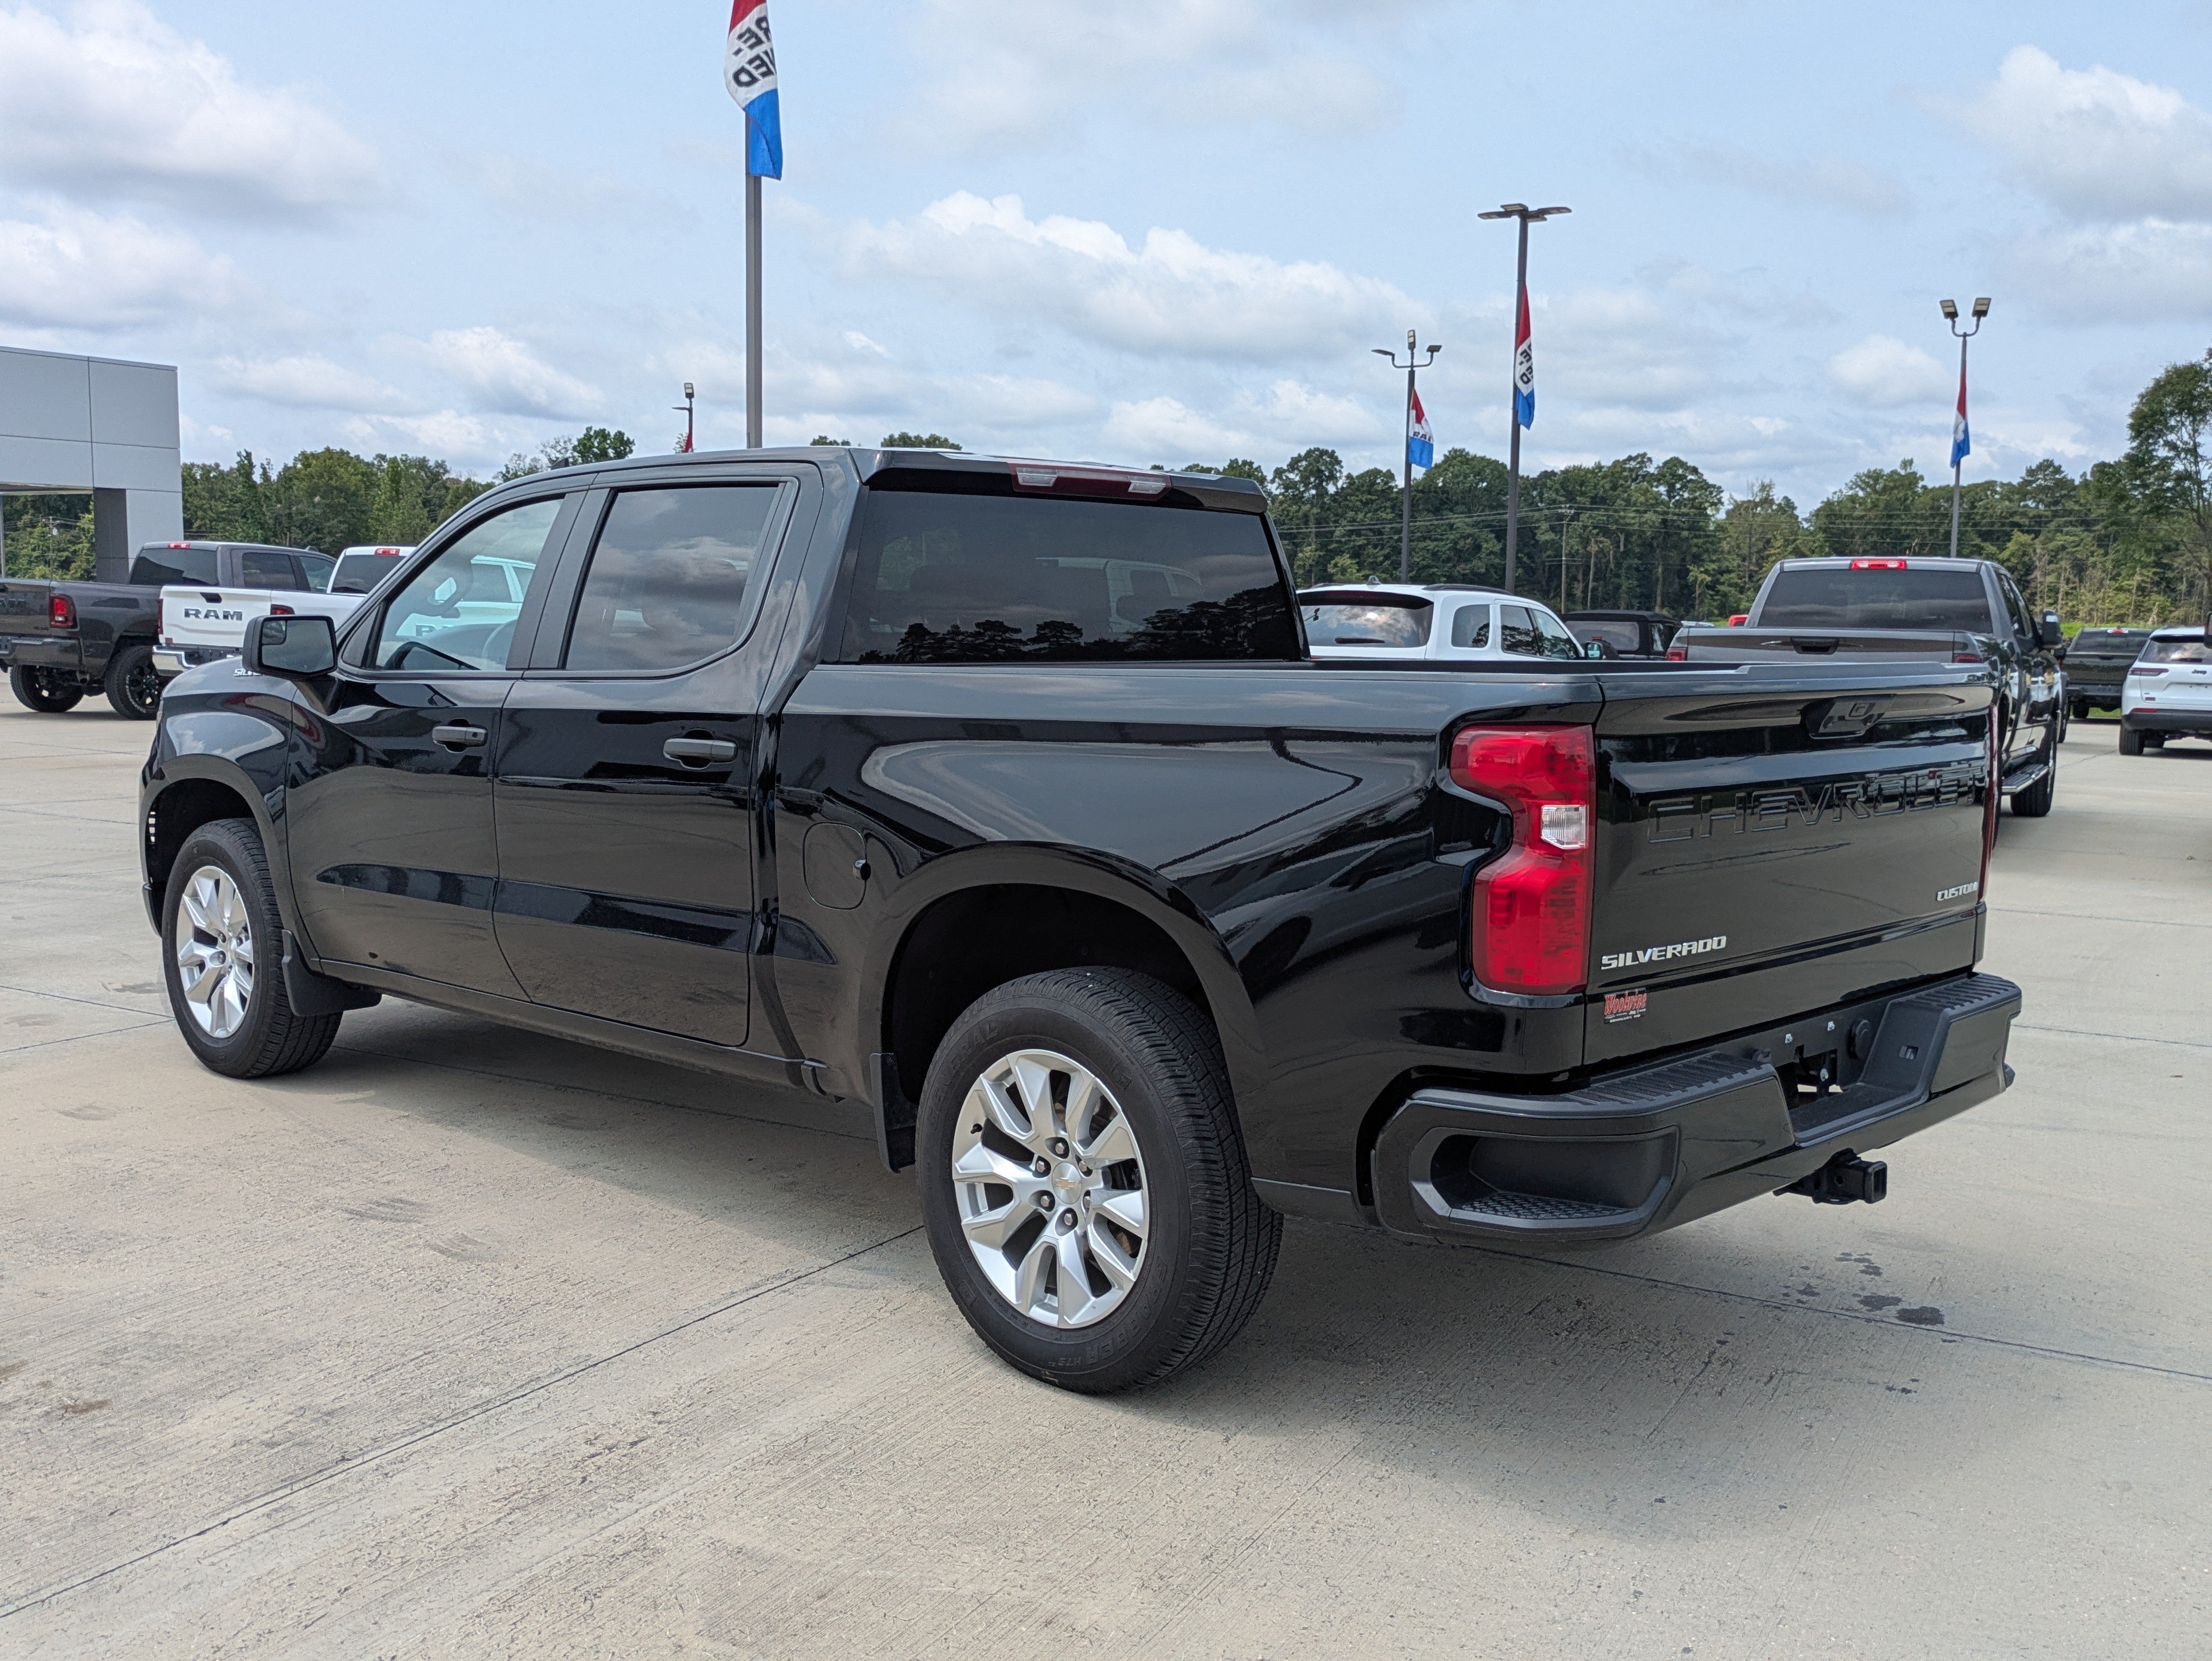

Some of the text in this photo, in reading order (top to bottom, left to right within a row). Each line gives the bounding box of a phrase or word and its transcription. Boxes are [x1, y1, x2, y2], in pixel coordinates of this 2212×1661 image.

[184, 608, 243, 621] RAM
[1647, 763, 1983, 844] CHEVROLET
[1601, 935, 1726, 970] SILVERADO
